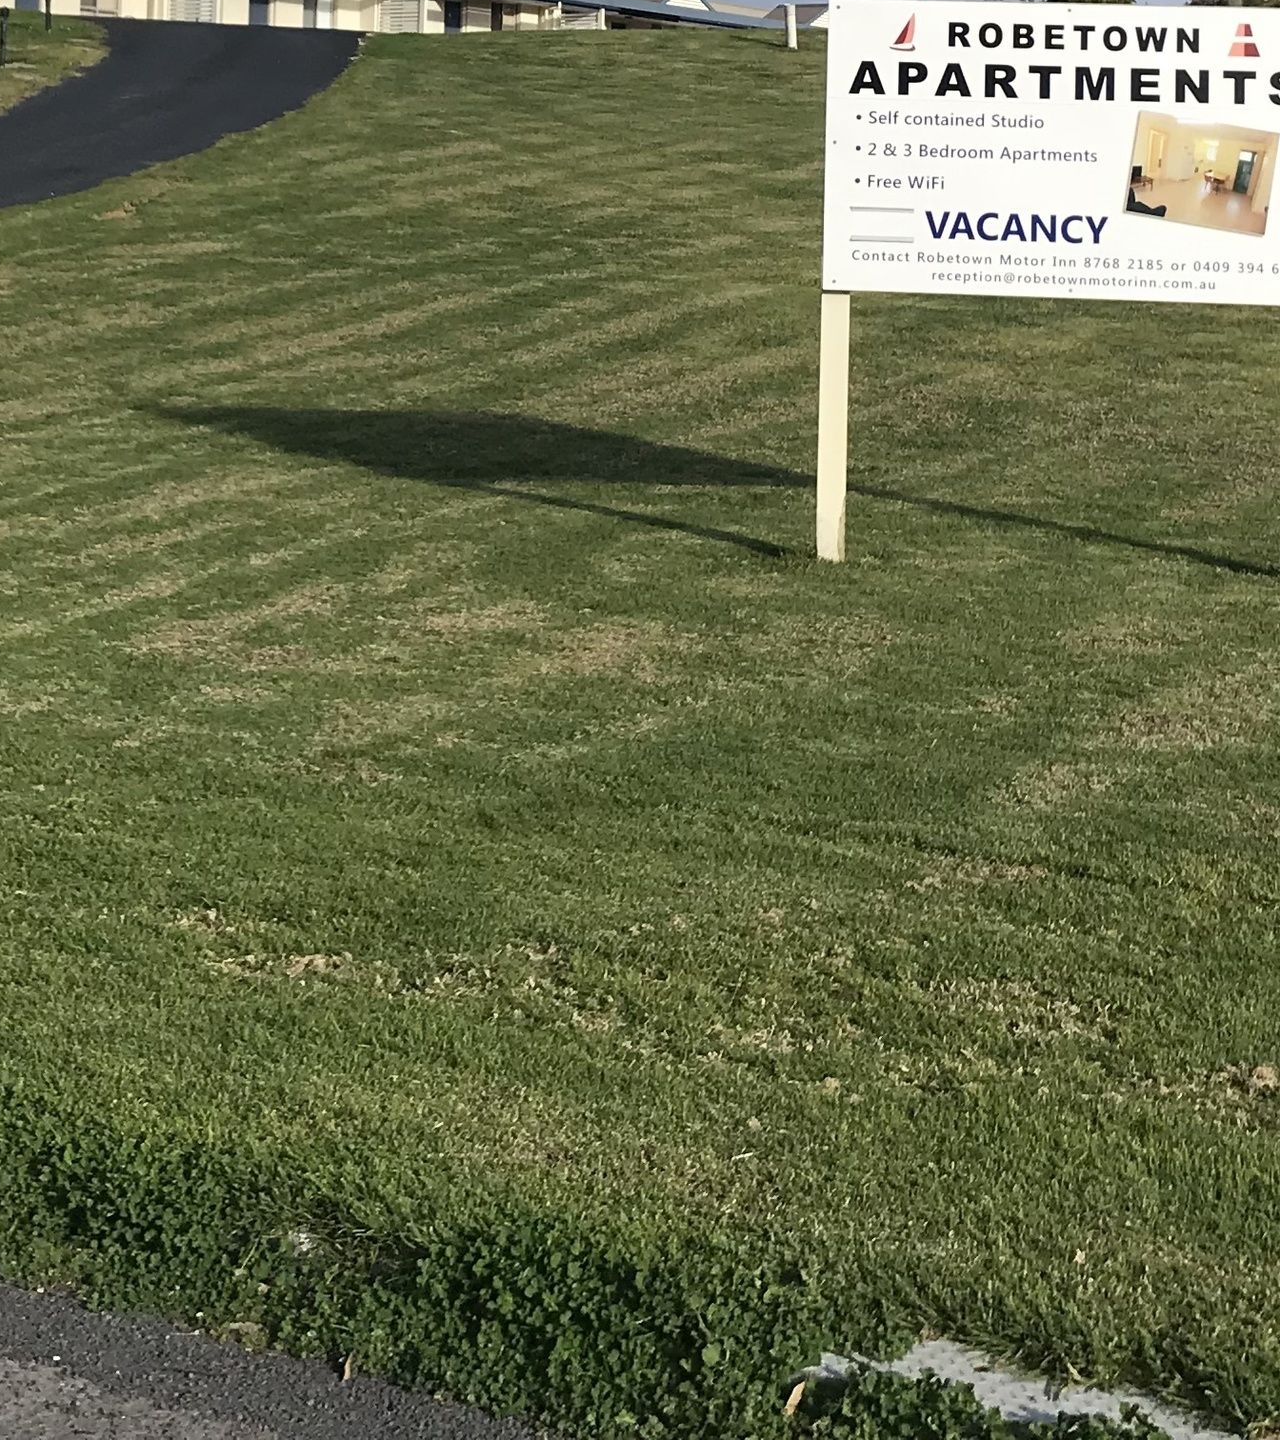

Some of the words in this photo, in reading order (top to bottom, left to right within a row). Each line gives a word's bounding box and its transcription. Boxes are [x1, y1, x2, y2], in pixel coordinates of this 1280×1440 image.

[948, 22, 1199, 53] ROBETOWN
[868, 110, 900, 125] Self
[904, 112, 985, 128] contained
[991, 113, 1045, 129] Studio
[867, 142, 877, 156] 2
[883, 142, 898, 157] &
[903, 143, 913, 158] 3
[919, 143, 994, 160] Bedroom
[999, 146, 1098, 164] Apartments
[867, 174, 902, 189] Free
[907, 175, 945, 190] WiFi
[925, 211, 1108, 244] VACANCY
[851, 249, 910, 263] Contact
[917, 251, 992, 265] Robetown
[999, 254, 1045, 267] Motor
[1052, 255, 1077, 268] Inn
[1083, 257, 1120, 269] 8768
[1127, 258, 1163, 271] 2185
[1170, 262, 1186, 271] or
[1193, 260, 1230, 273] 0409
[1238, 262, 1264, 274] 394
[931, 271, 1216, 291] reception@robetownmotorinn.com.au
